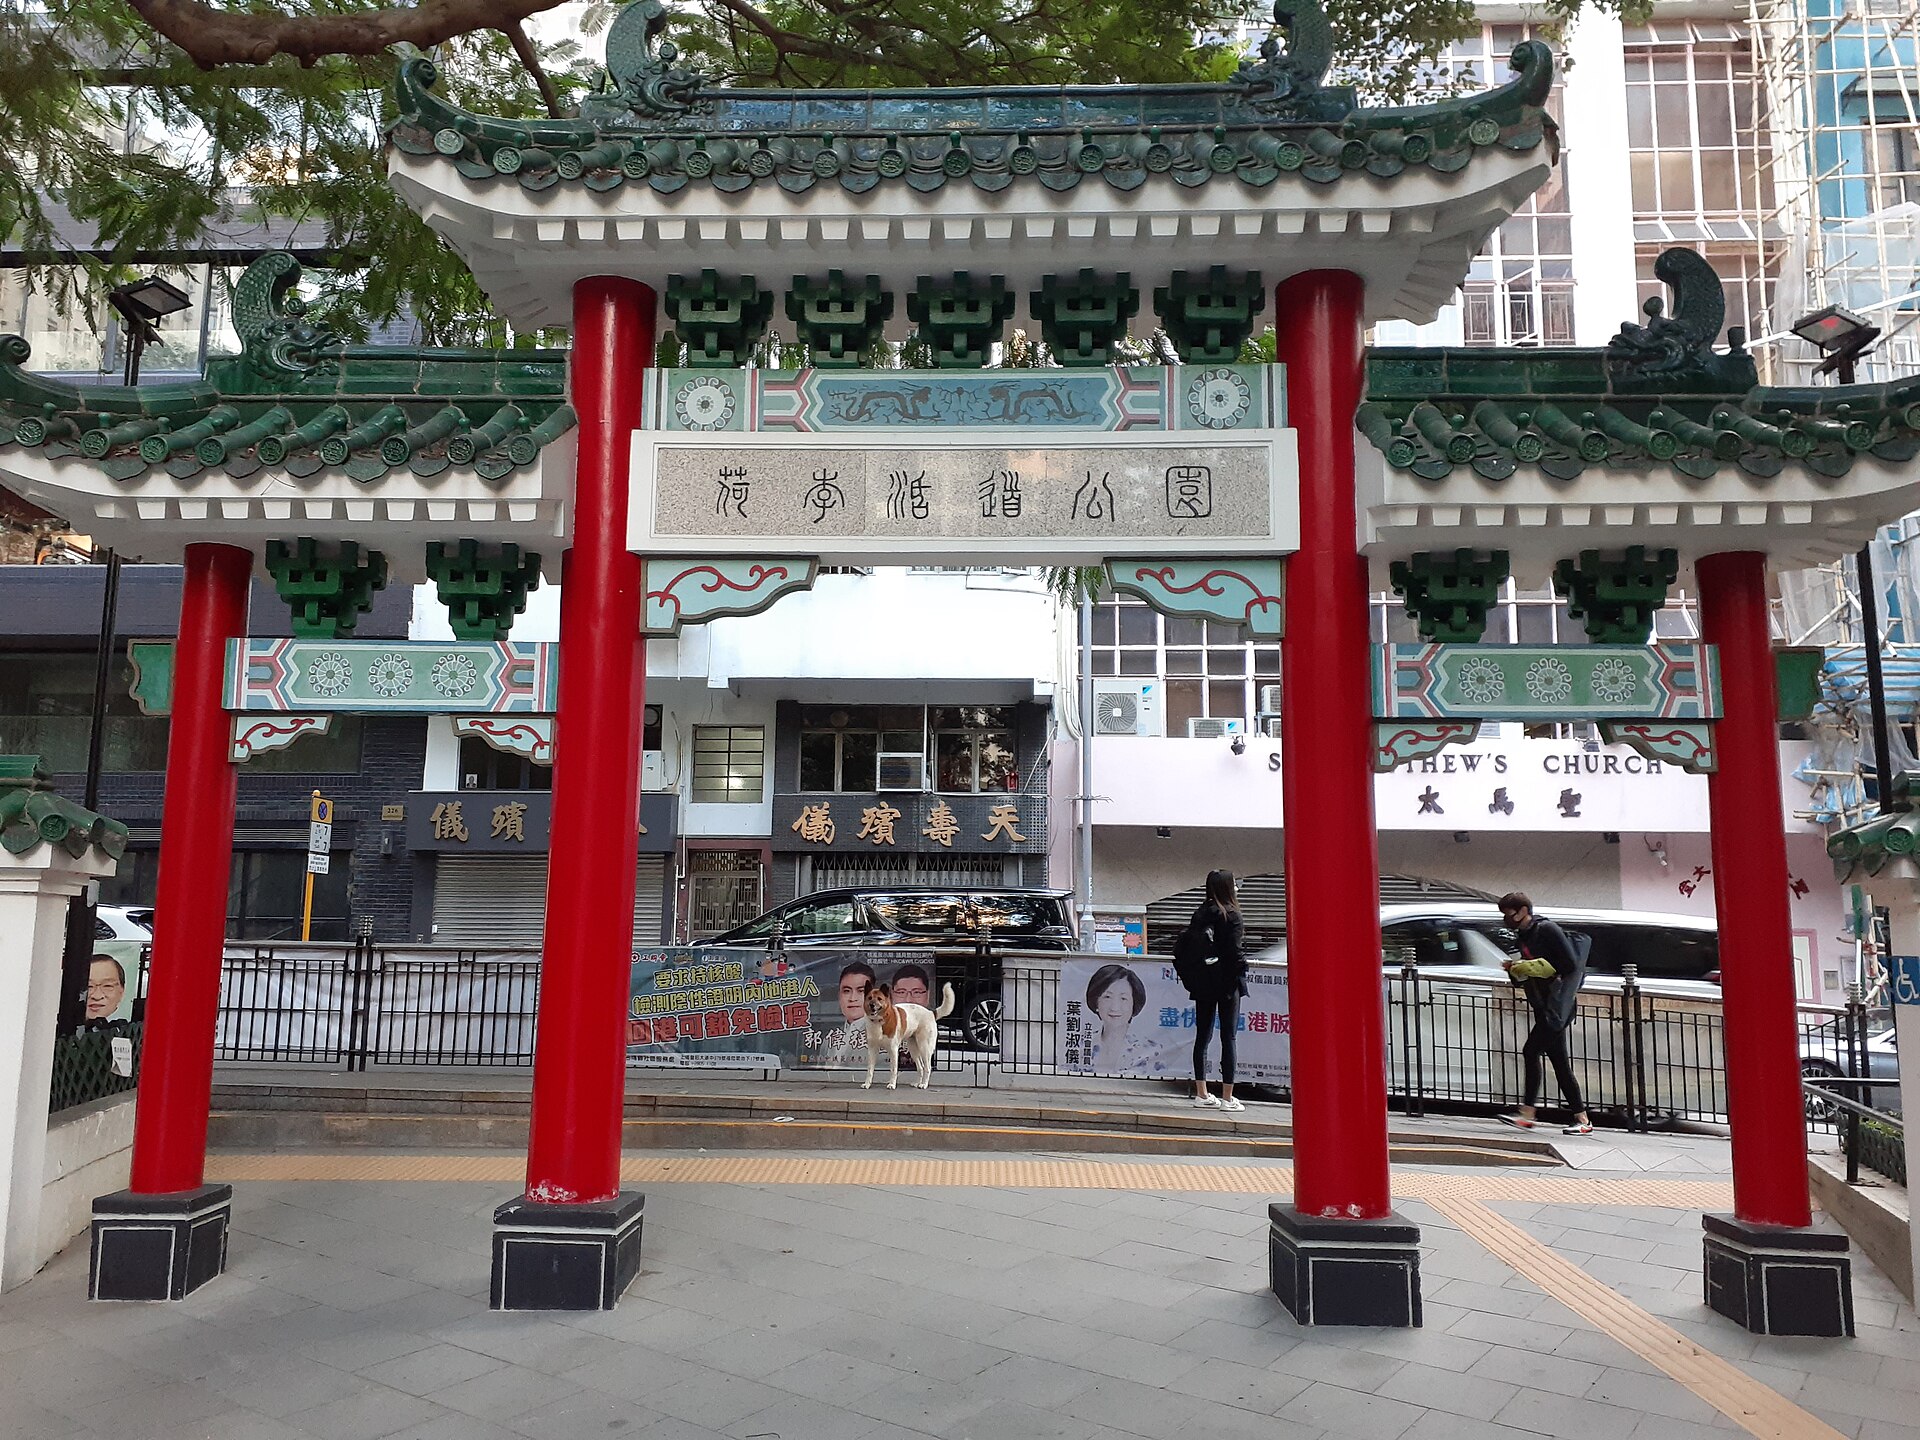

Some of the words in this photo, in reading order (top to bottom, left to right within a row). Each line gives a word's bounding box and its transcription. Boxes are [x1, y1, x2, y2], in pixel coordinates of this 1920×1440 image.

[1268, 753, 1281, 772] S
[1406, 753, 1508, 774] HEW'S
[1543, 754, 1663, 775] CHURCH
[654, 962, 743, 989] 要求持核酸
[1065, 1001, 1081, 1064] 葉劉淑儀
[1083, 1022, 1092, 1065] 立法會議員
